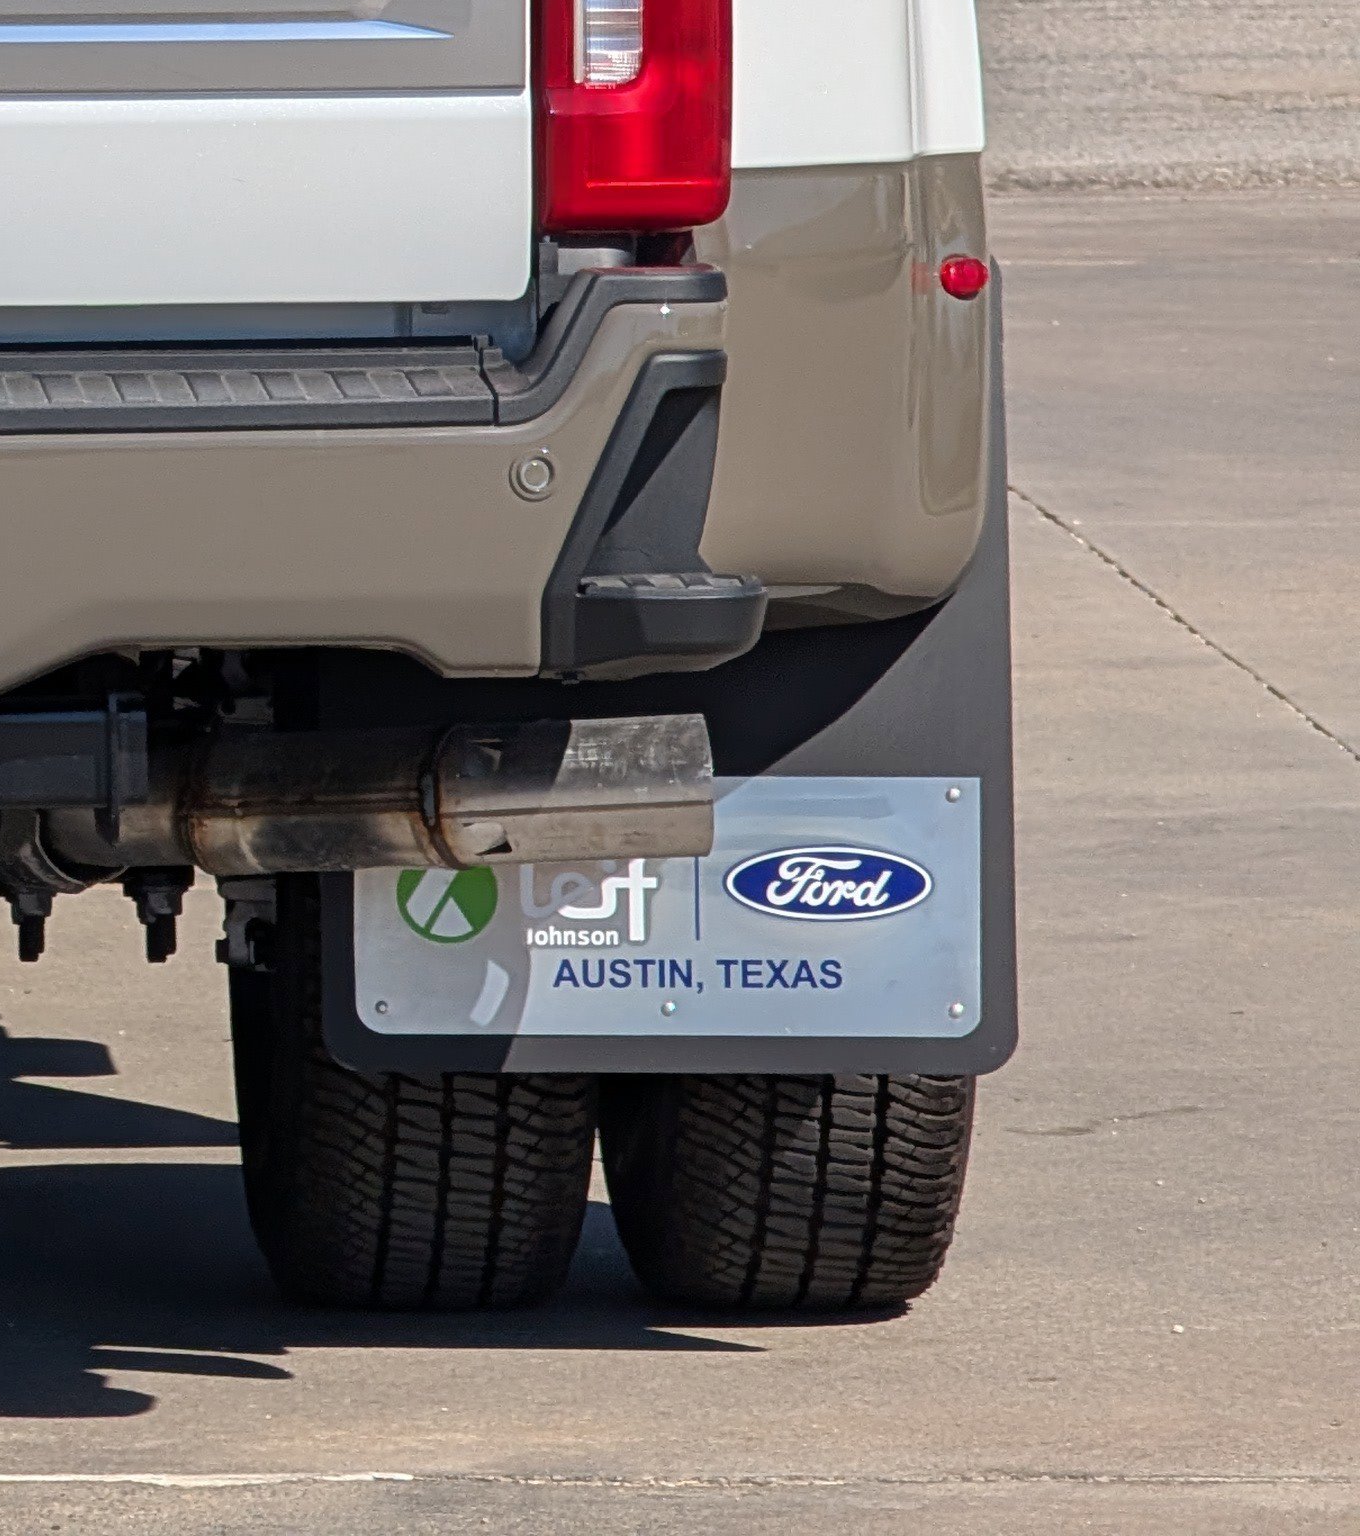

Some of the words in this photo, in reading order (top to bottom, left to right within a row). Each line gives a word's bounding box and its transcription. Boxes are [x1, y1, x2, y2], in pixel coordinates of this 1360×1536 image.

[765, 856, 894, 906] Ford
[552, 958, 705, 994] AUSTIN,
[715, 958, 844, 990] TEXAS
